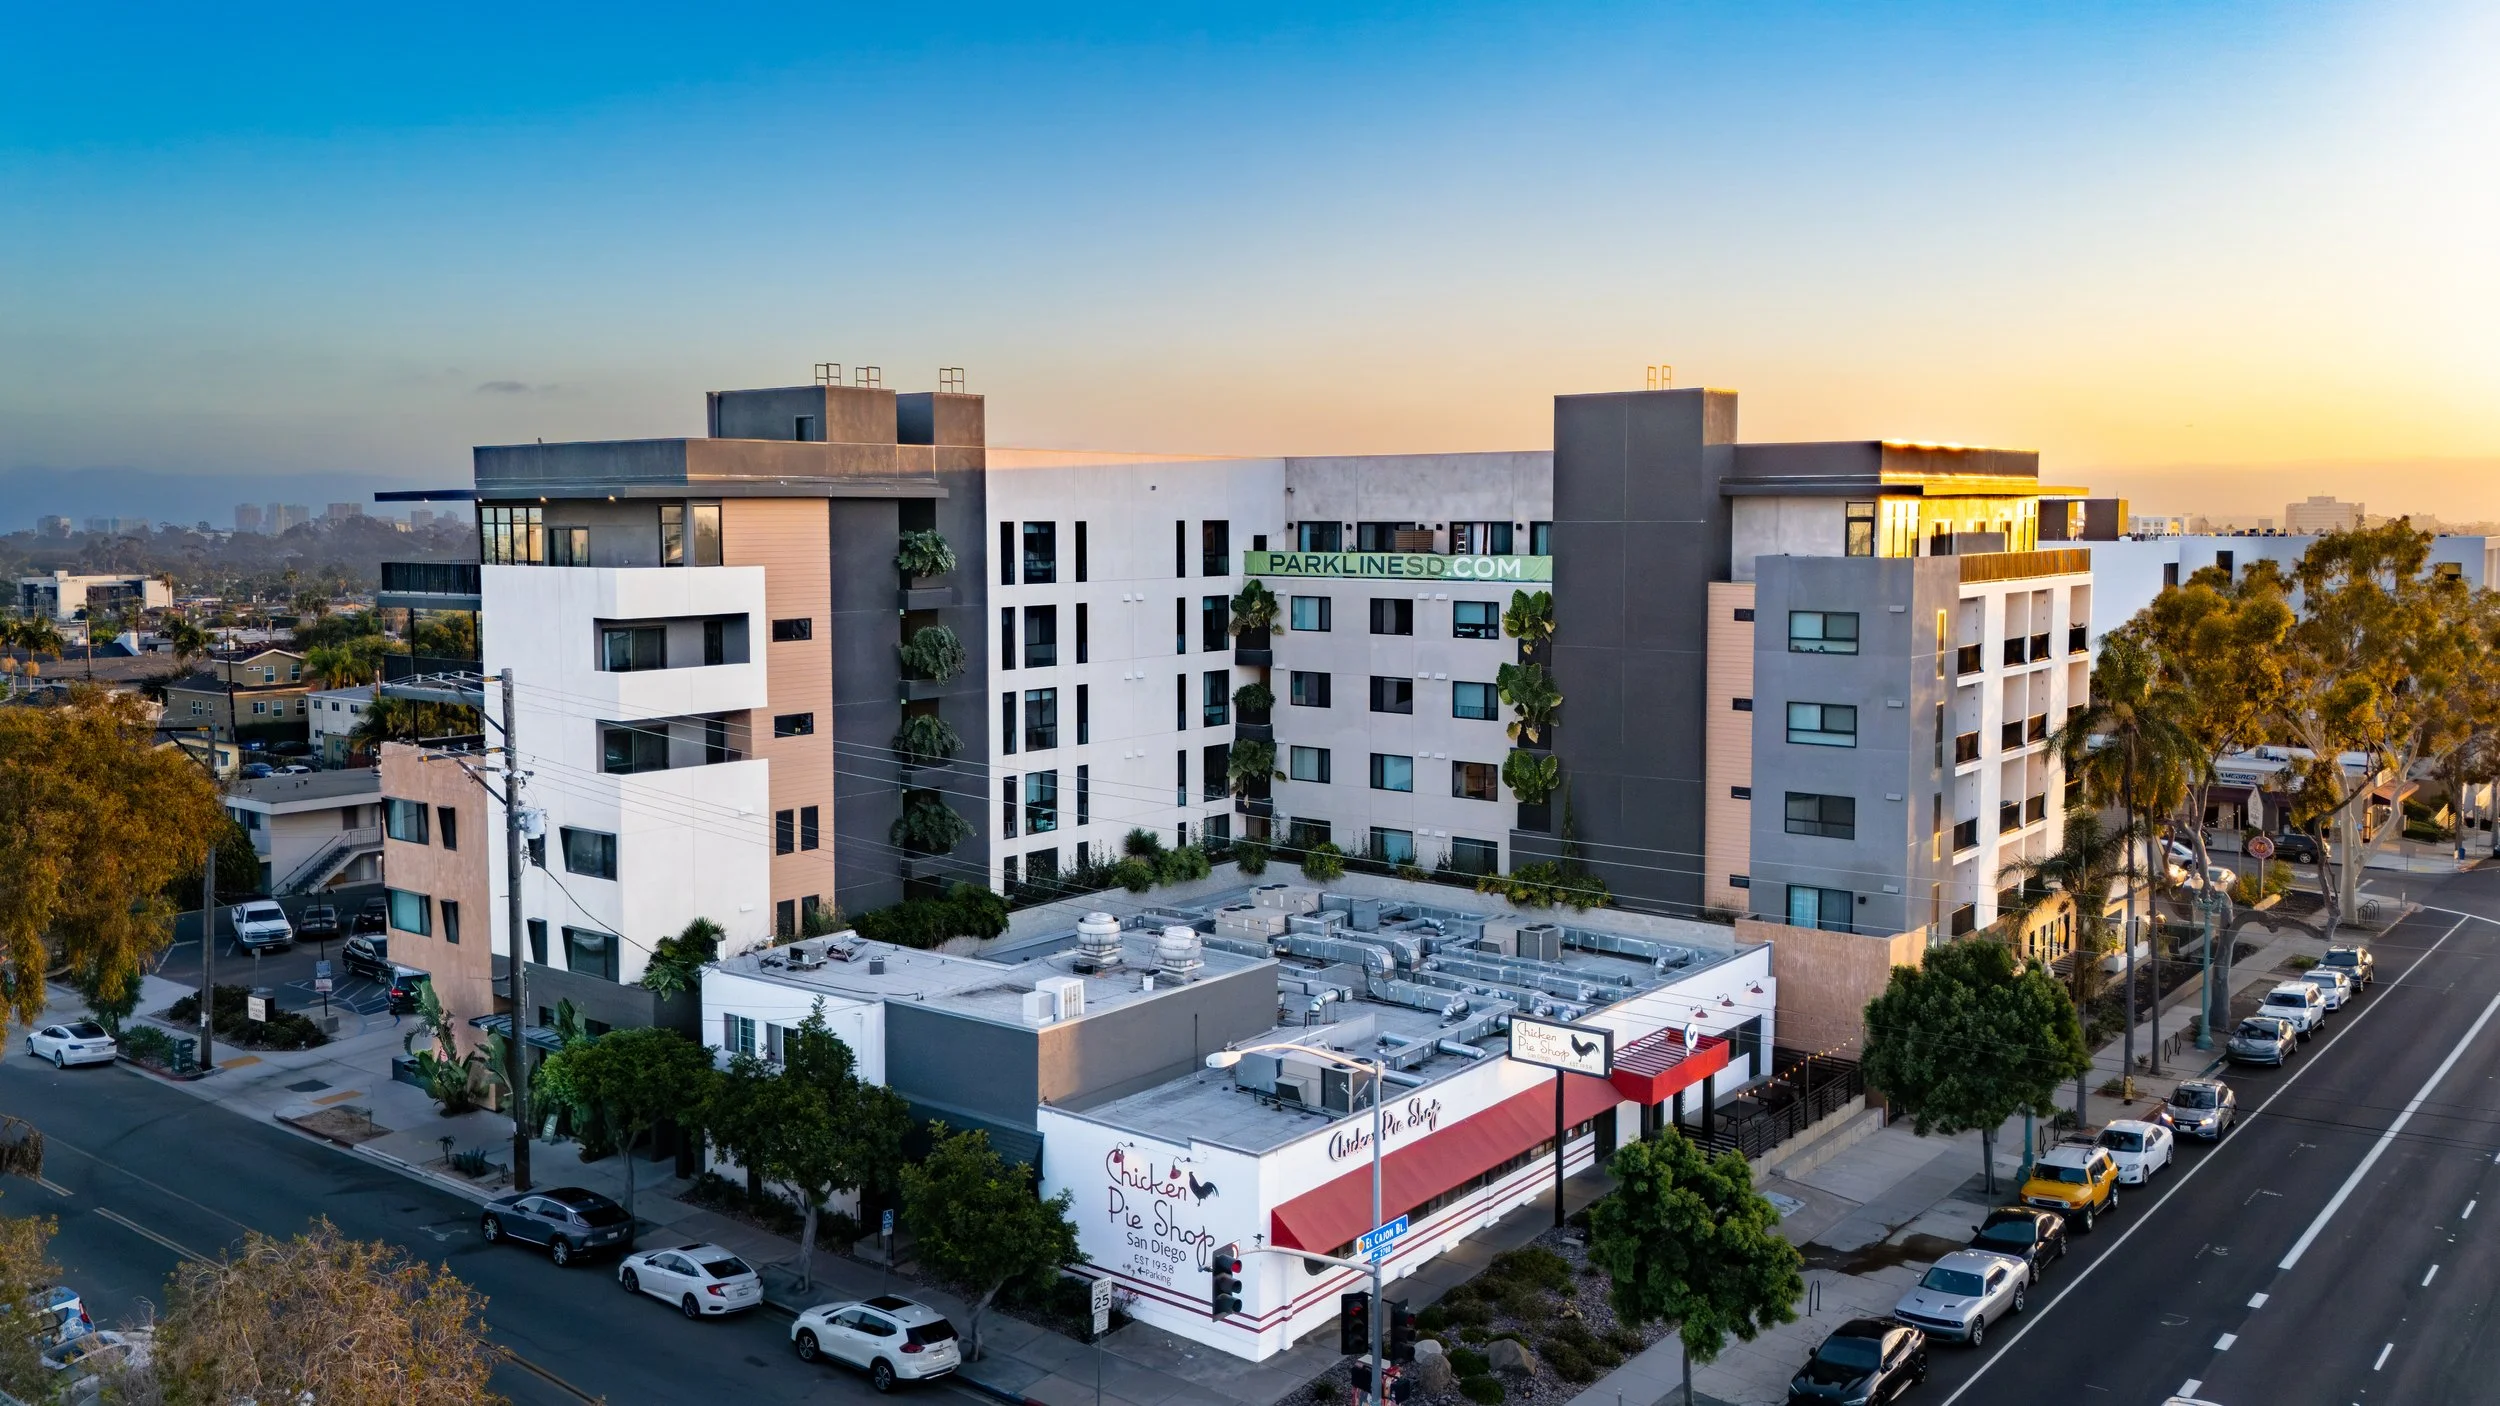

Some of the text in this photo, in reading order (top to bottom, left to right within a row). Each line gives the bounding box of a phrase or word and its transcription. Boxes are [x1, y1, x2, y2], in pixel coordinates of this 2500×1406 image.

[1269, 554, 1521, 578] PARKLINESD.COM
[1517, 1021, 1557, 1041] Chicken
[1518, 1035, 1570, 1062] Pie Shop
[1382, 1109, 1404, 1140] Pie
[1408, 1097, 1442, 1132] Shop
[1106, 1149, 1187, 1201] Chicken
[1108, 1185, 1216, 1268] Pie Shop
[1126, 1231, 1187, 1264] San Diego
[1365, 1237, 1373, 1250] EL
[1374, 1227, 1394, 1245] CAJON
[1134, 1254, 1175, 1275] EST 1938
[1094, 1280, 1110, 1290] SPEED
[1145, 1270, 1172, 1287] Parking
[1094, 1293, 1110, 1310] 25
[1095, 1287, 1108, 1296] LIMIT
